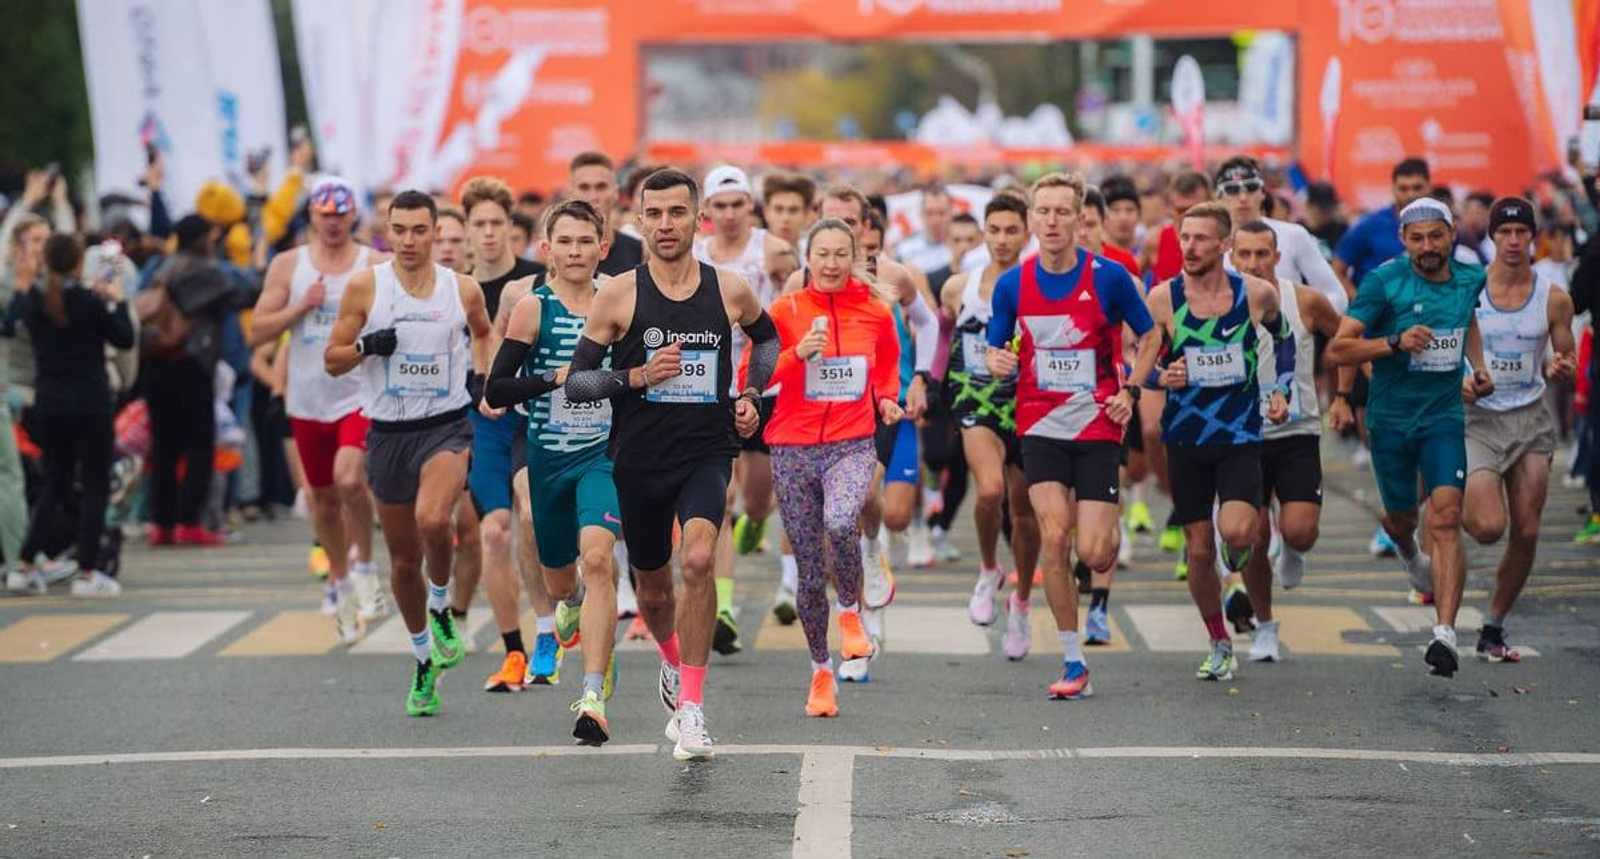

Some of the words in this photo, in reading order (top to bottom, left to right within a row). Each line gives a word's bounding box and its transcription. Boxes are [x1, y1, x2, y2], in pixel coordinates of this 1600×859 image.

[666, 329, 722, 347] insanity
[1048, 360, 1080, 370] 4157
[1197, 353, 1233, 367] 5383
[1491, 360, 1522, 371] 5213
[399, 363, 440, 375] 5066
[679, 363, 706, 376] 98
[819, 367, 853, 380] 3514
